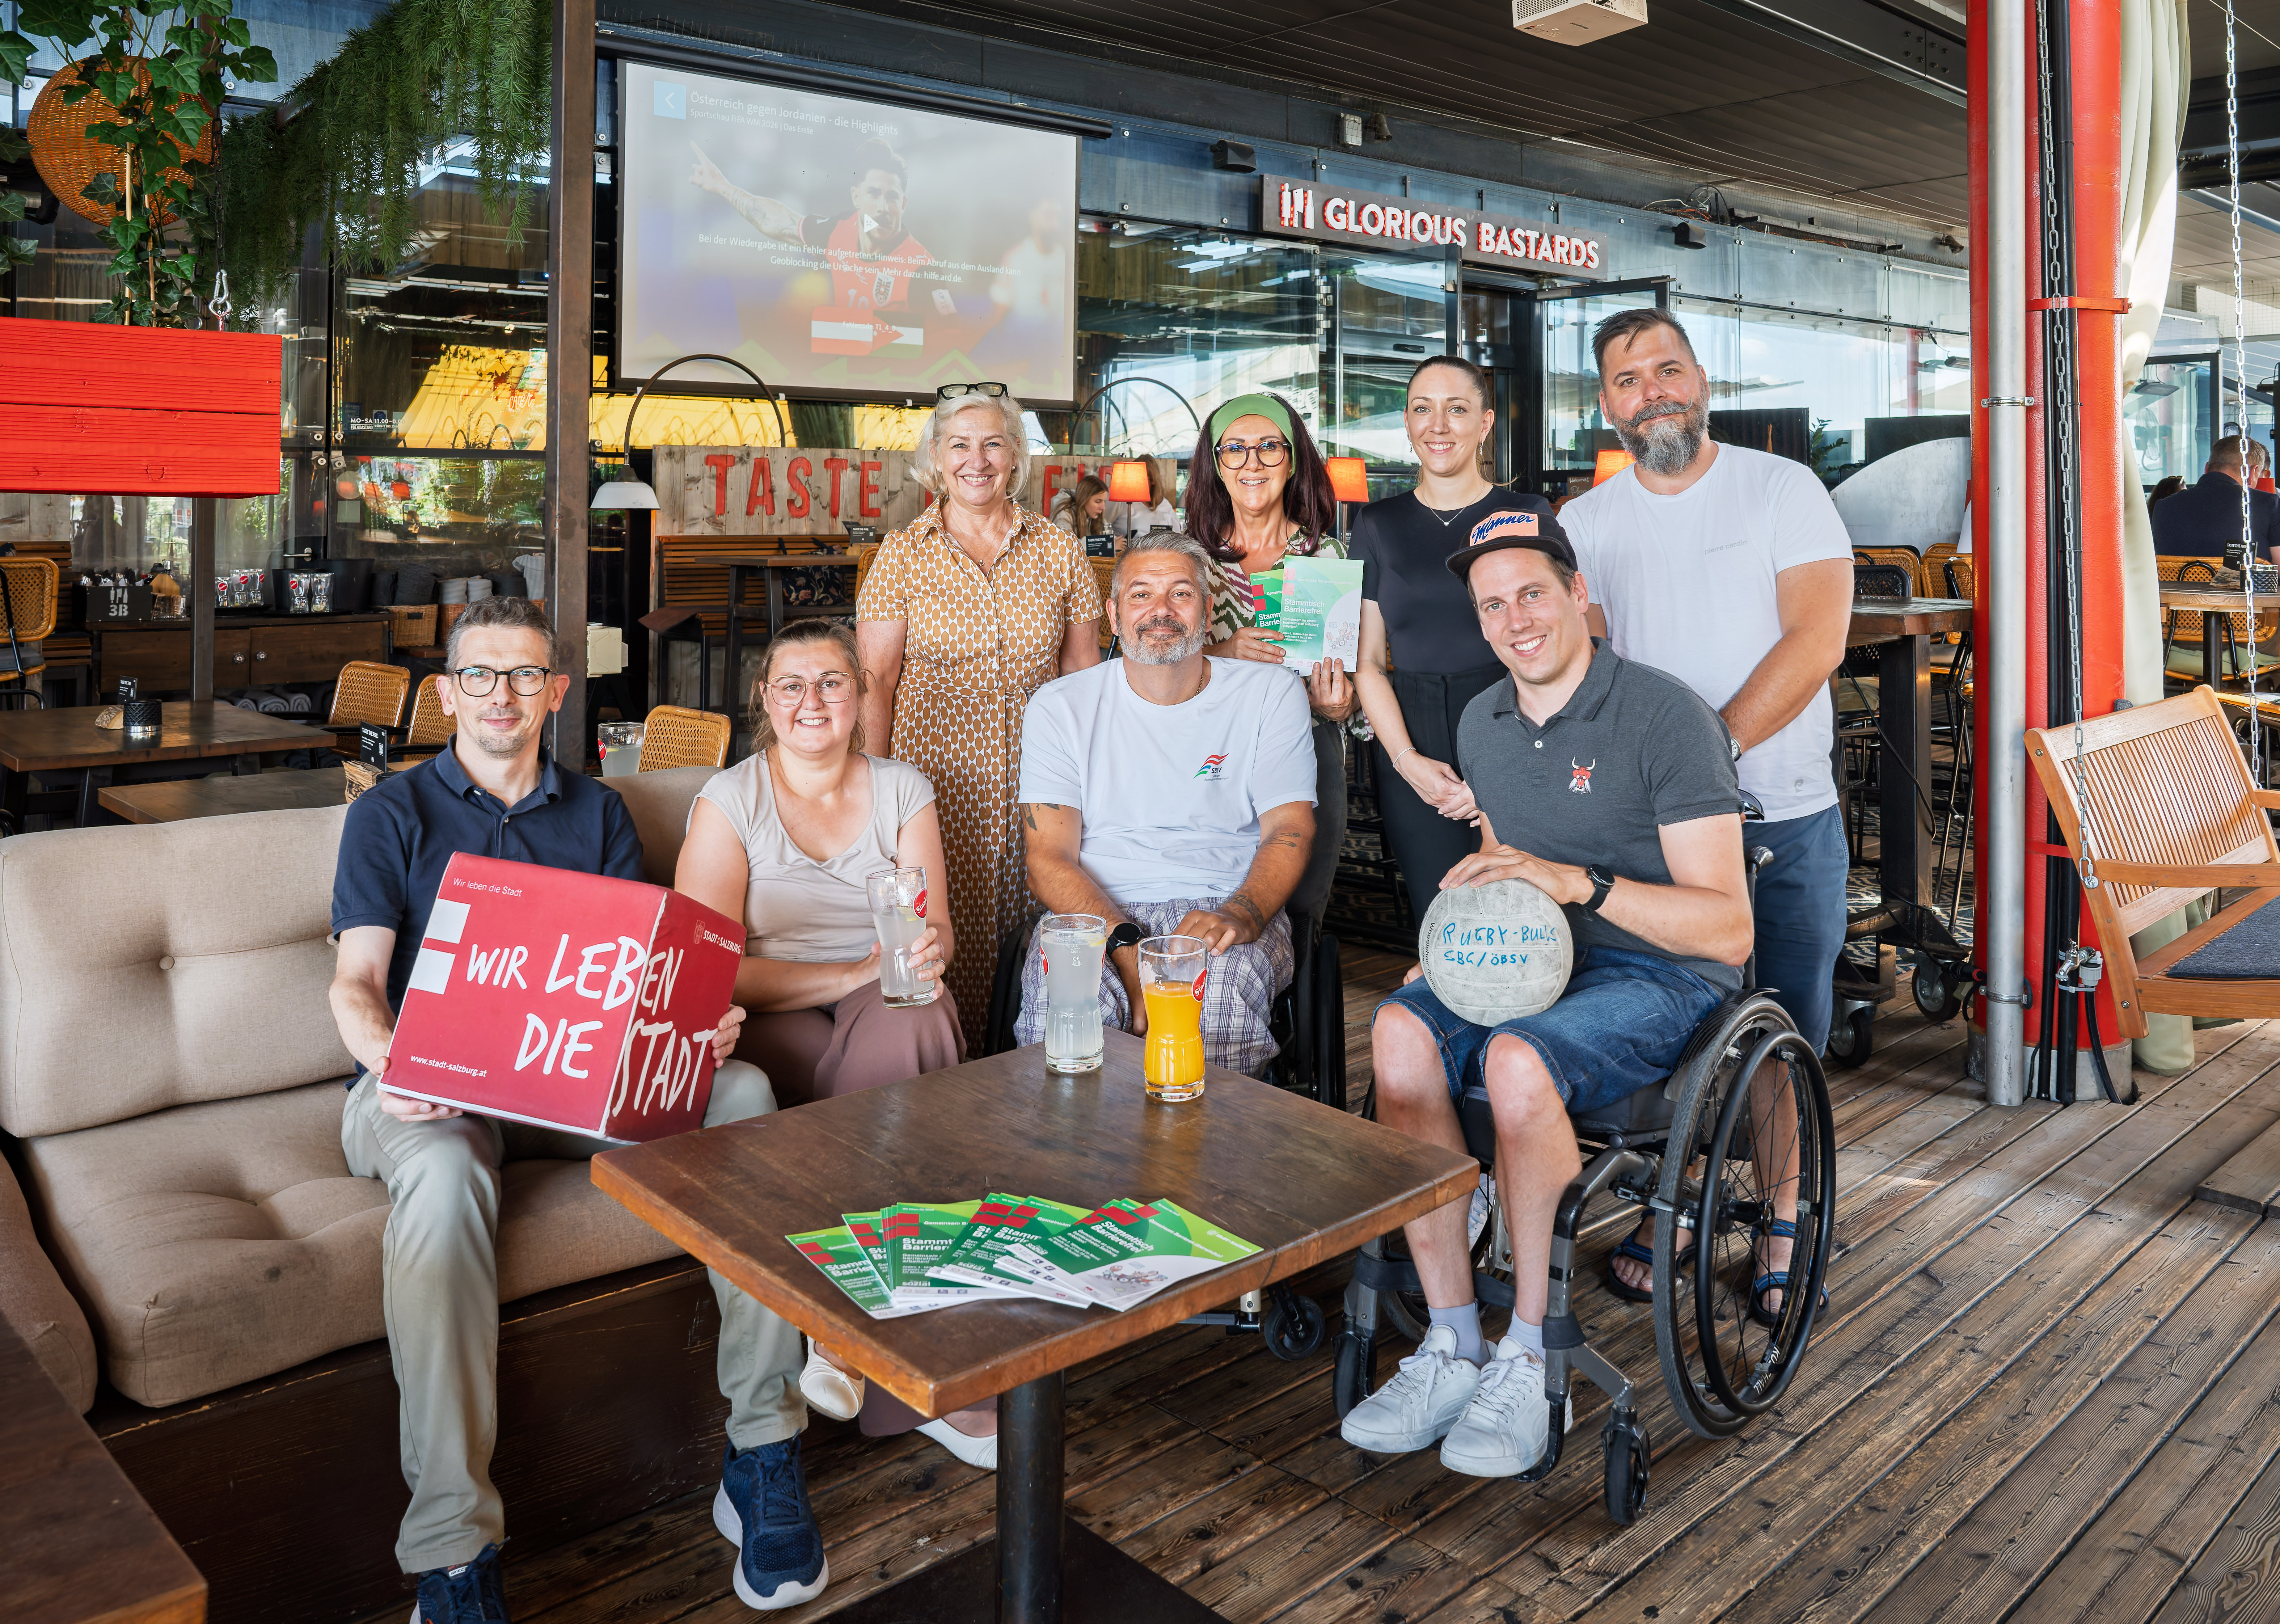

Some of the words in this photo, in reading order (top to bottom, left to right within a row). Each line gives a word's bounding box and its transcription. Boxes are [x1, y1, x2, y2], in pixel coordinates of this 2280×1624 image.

[690, 109, 729, 121] Sportschau
[731, 115, 745, 124] FIFA
[746, 117, 760, 126] WM
[761, 120, 779, 129] 2026
[783, 123, 796, 132] Das
[797, 125, 814, 134] Erste
[691, 90, 744, 110] Österreich
[747, 104, 776, 124] gegen
[778, 107, 826, 123] Jordanien
[834, 116, 849, 127] die
[852, 119, 898, 136] Highlights
[1324, 197, 1467, 248] GLORIOUS
[1478, 222, 1600, 269] BASTARDS
[699, 233, 712, 243] Bei
[714, 235, 727, 245] der
[729, 237, 777, 250] Wiedergabe
[778, 242, 788, 251] ist
[789, 243, 801, 253] ein
[803, 244, 826, 255] Fehler
[828, 248, 873, 260] aufgetreten.
[875, 253, 906, 263] Hinweis:
[908, 256, 925, 265] Beim
[927, 258, 947, 267] Abruf
[961, 262, 976, 271] dem
[977, 264, 1004, 274] Ausland
[1005, 266, 1021, 275] kann
[770, 256, 819, 270] Geoblocking
[820, 260, 831, 270] die
[833, 262, 863, 272] Ursache
[883, 267, 902, 276] Mehr
[903, 269, 922, 278] dazu:
[924, 271, 963, 283] hilfe.ard.de.
[705, 454, 882, 519] TASTE
[1472, 514, 1535, 545] Manner
[1705, 546, 1723, 555] pierre
[1726, 540, 1747, 549] cardin
[109, 605, 128, 616] 3B
[1284, 598, 1325, 607] Stammtisch
[1284, 606, 1322, 615] Barrierefrei
[453, 877, 466, 887] Wir
[467, 881, 487, 890] leben
[489, 884, 501, 893] die
[502, 886, 522, 897] Stadt
[703, 930, 718, 944] STADT
[719, 937, 741, 954] SALZBURG
[1425, 923, 1435, 968] Wheelchair
[466, 944, 529, 990] WIR
[545, 933, 684, 1016] LEBEN
[411, 1055, 487, 1077] www.stadt-salzburg.at
[514, 1013, 603, 1079] DIE
[612, 1018, 718, 1117] STADT
[1090, 1224, 1144, 1253] Barrierefrei
[1101, 1221, 1154, 1251] Stammtisch
